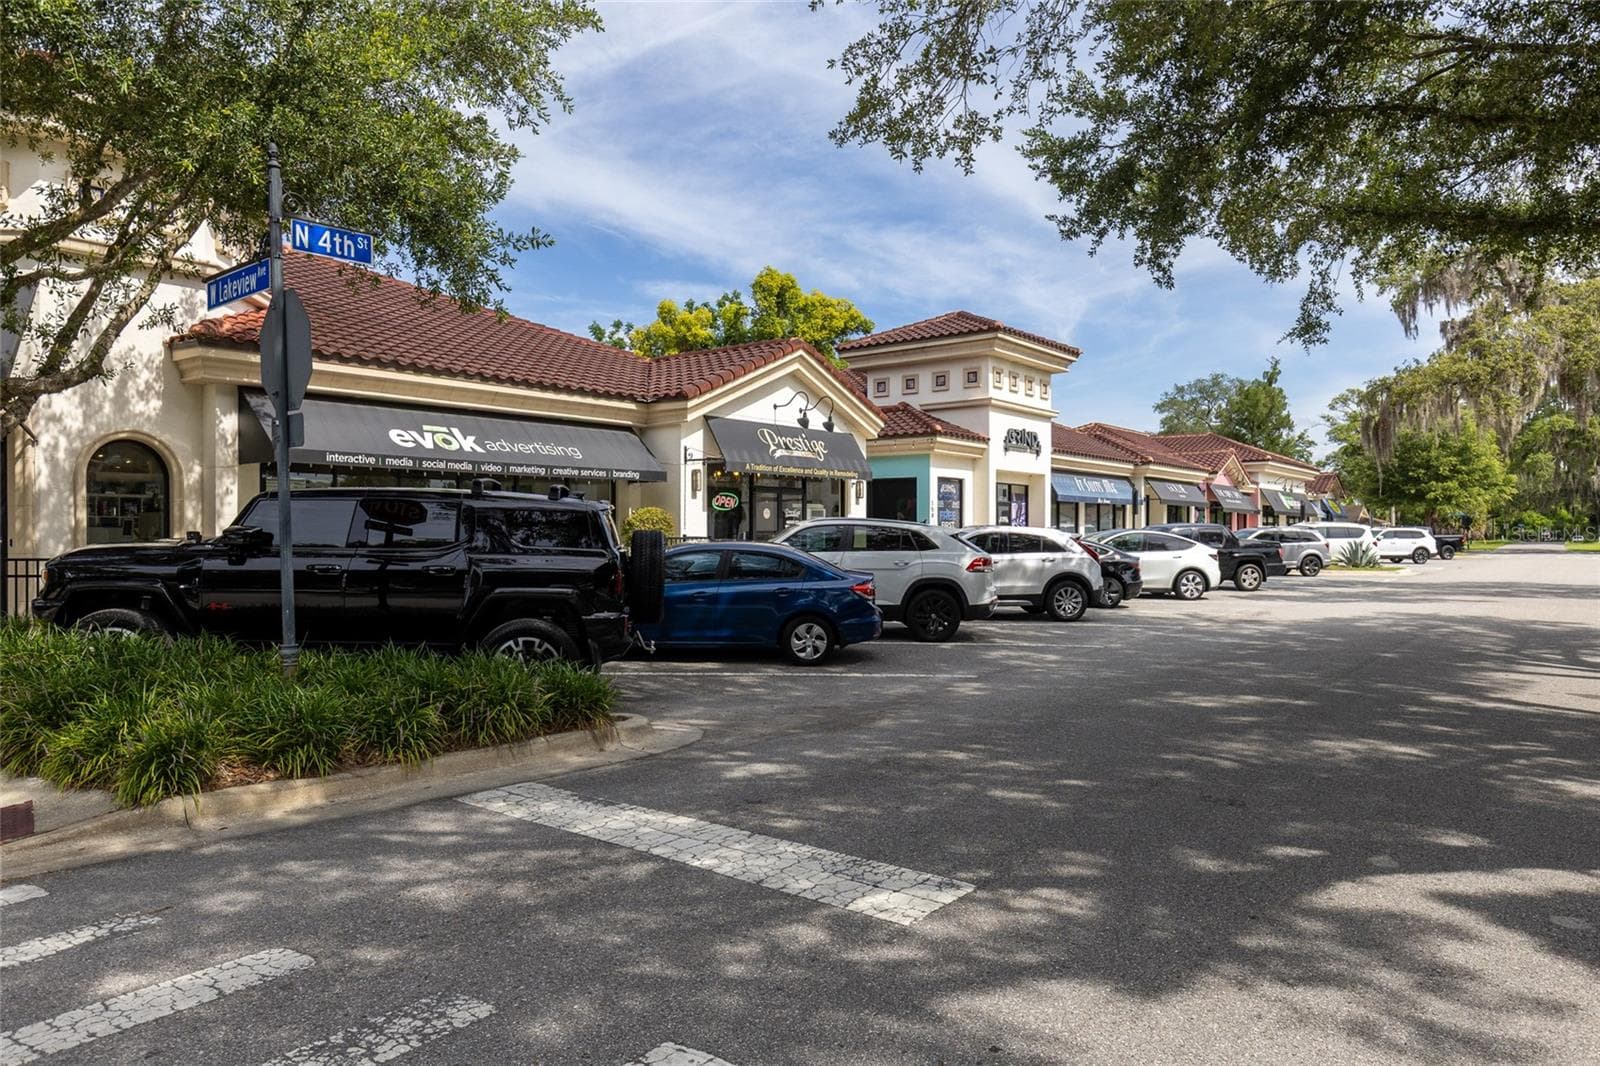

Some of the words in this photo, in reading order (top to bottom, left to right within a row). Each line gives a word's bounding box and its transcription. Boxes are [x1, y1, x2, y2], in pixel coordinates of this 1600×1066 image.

[295, 224, 309, 249] N
[318, 230, 356, 258] 4th
[357, 237, 369, 250] St
[209, 284, 217, 305] W
[219, 272, 257, 302] Lakeview
[257, 266, 266, 278] Ave
[484, 438, 583, 460] advertising
[757, 428, 829, 462] Prestige
[326, 452, 376, 465] interactive
[385, 457, 413, 467] media
[422, 459, 446, 469] social
[447, 461, 473, 471] media
[480, 463, 502, 473] video
[509, 465, 546, 477] marketing
[552, 467, 579, 477] creative
[580, 468, 607, 478] services
[612, 470, 640, 480] branding
[751, 464, 773, 472] Tradition
[774, 465, 779, 473] of
[779, 465, 804, 474] Excellence
[813, 468, 829, 477] Quality
[714, 495, 736, 509] OPEN
